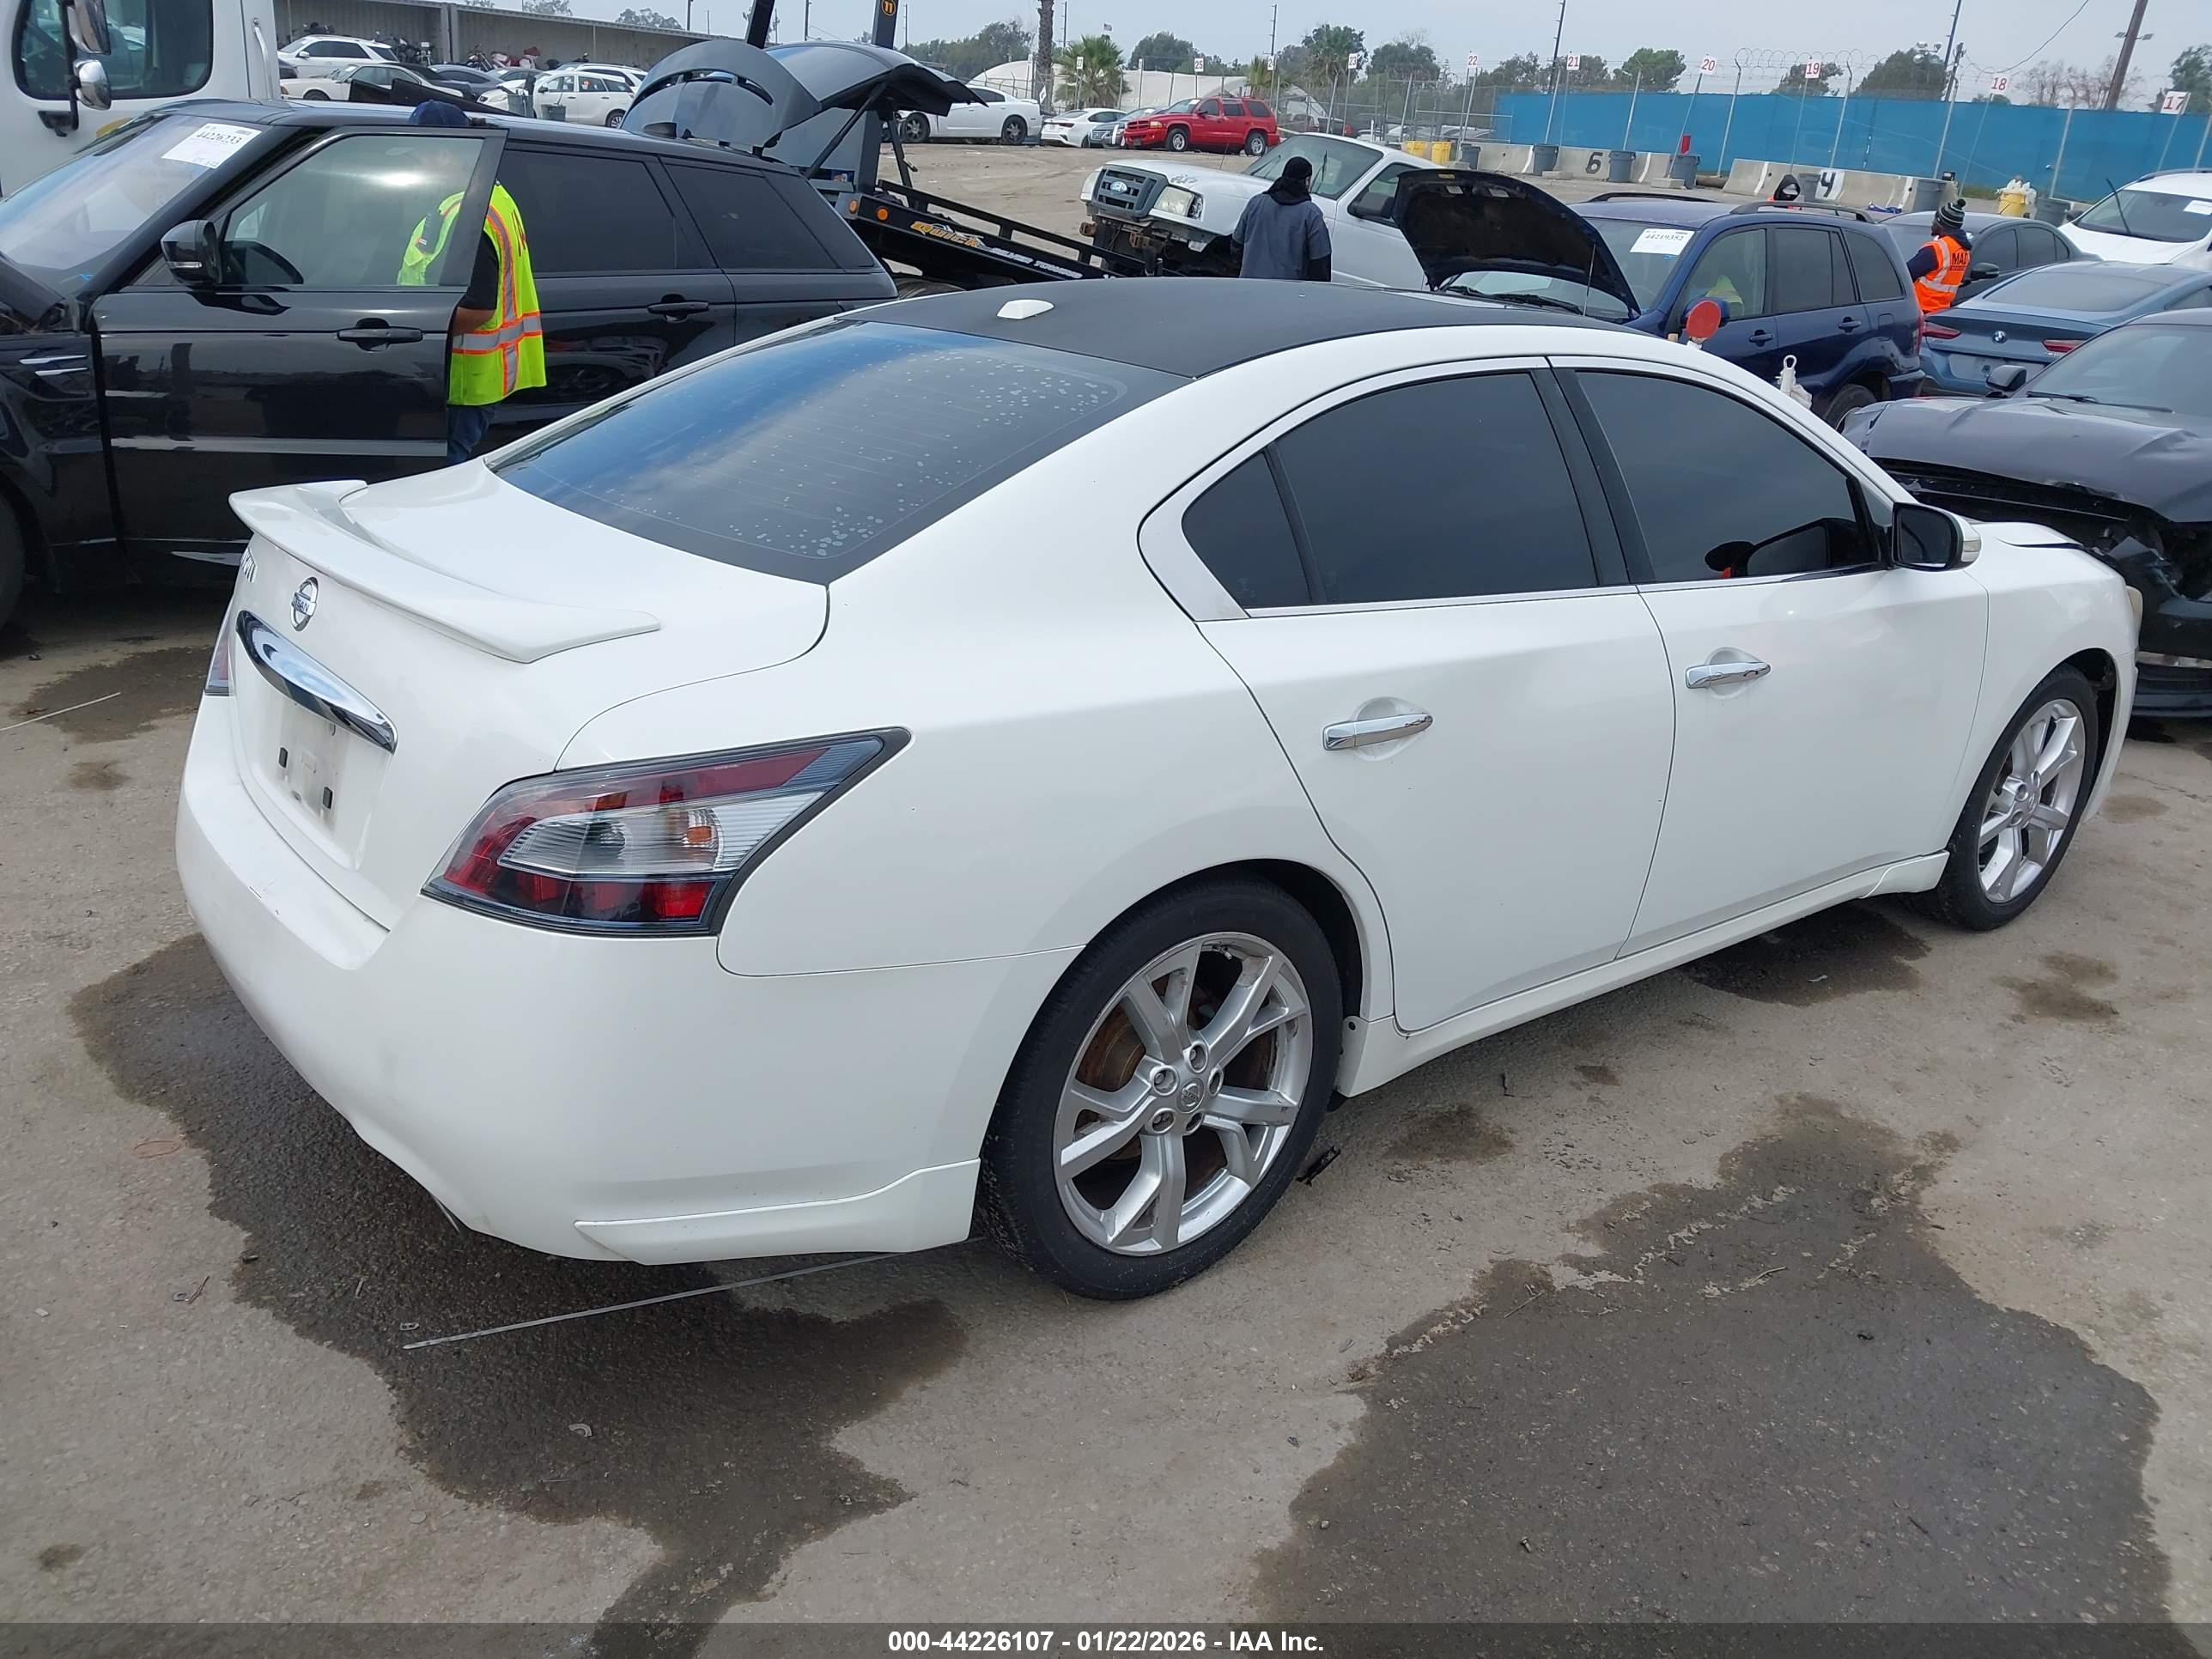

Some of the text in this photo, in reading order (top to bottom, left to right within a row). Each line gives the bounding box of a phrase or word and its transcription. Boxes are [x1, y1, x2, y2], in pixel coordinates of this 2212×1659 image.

[1194, 60, 1203, 70] 25
[1349, 56, 1357, 66] 23
[1468, 55, 1478, 65] 22
[1567, 56, 1579, 67] 21
[1701, 58, 1716, 71] 20
[1806, 62, 1820, 75] 19
[1990, 77, 2008, 91] 18
[2163, 95, 2186, 111] 17
[1585, 151, 1603, 174] 6
[1820, 172, 1836, 198] 4
